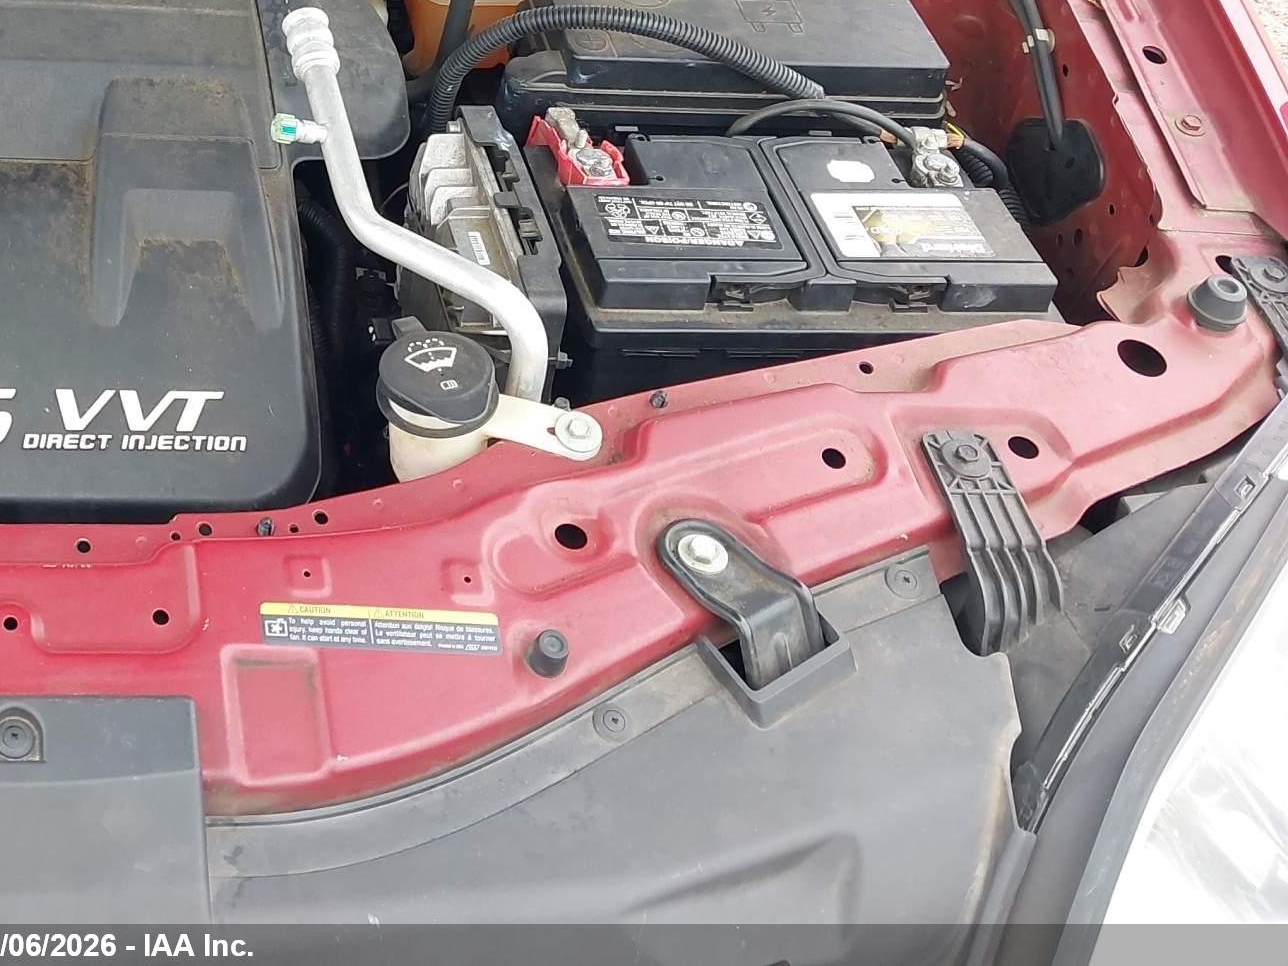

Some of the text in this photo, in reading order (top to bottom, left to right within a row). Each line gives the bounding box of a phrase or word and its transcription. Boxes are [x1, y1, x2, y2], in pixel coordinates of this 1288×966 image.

[55, 388, 225, 433] VVT
[22, 433, 247, 452] DIRECT INJECTION
[300, 606, 331, 614] CAUTION
[385, 610, 424, 618] ATTENTION
